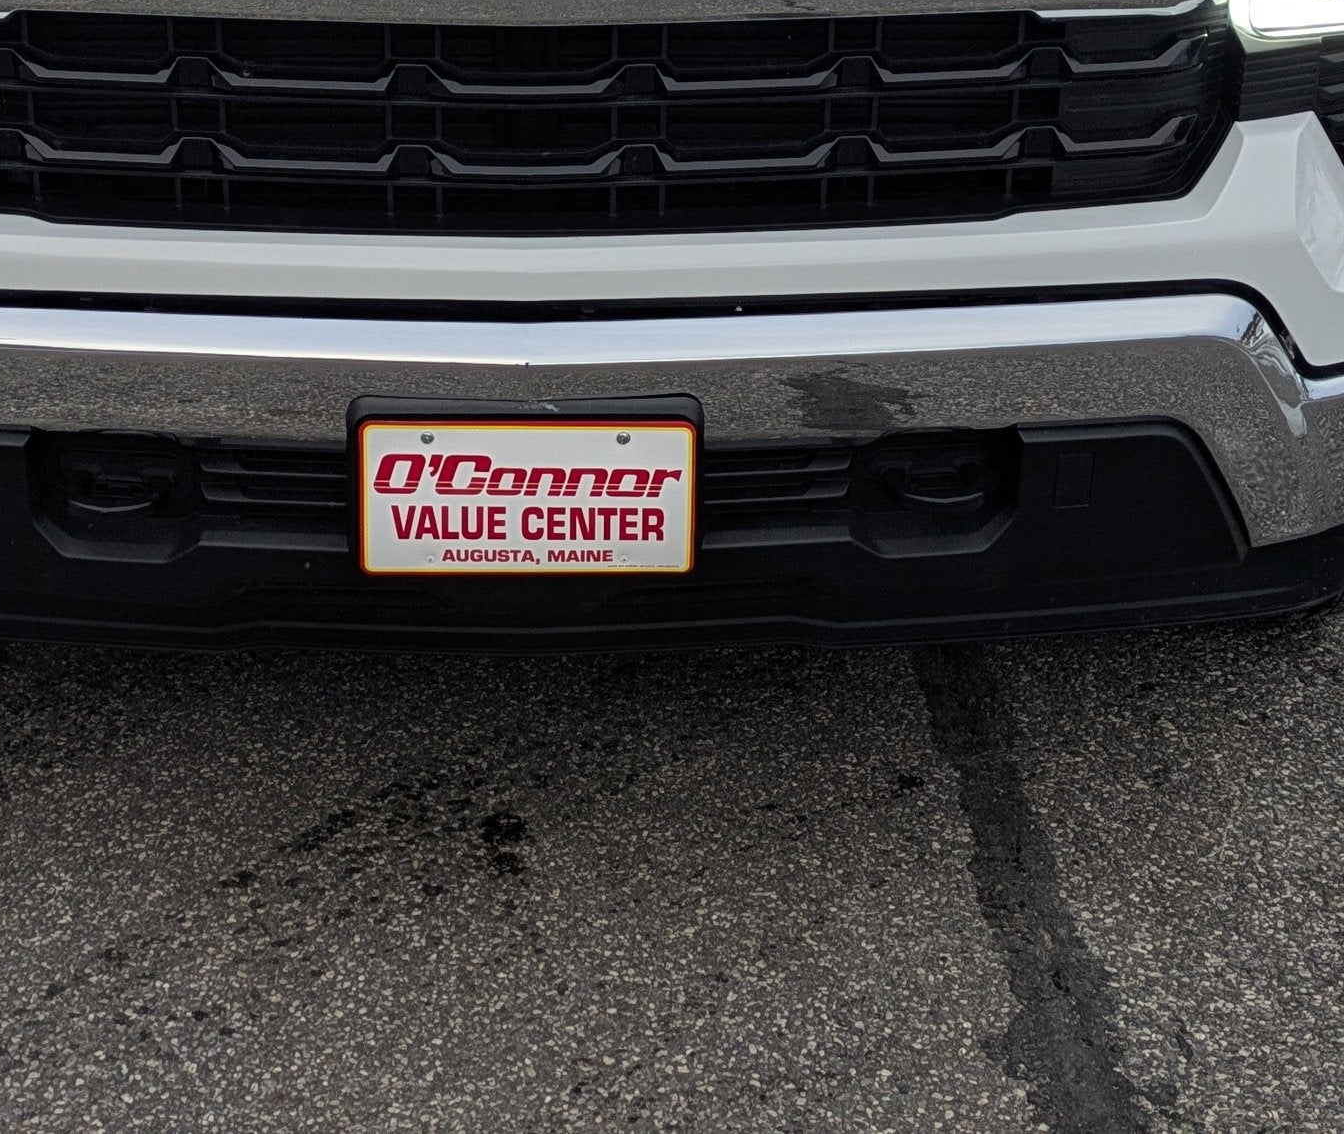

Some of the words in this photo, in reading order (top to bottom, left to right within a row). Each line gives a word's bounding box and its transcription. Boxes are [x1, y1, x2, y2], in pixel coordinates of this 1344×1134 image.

[373, 454, 683, 498] O'Connor
[392, 505, 506, 541] VALUE
[522, 507, 664, 542] CENTER
[442, 549, 541, 565] AUGUSTA,
[547, 550, 613, 563] MAINE
